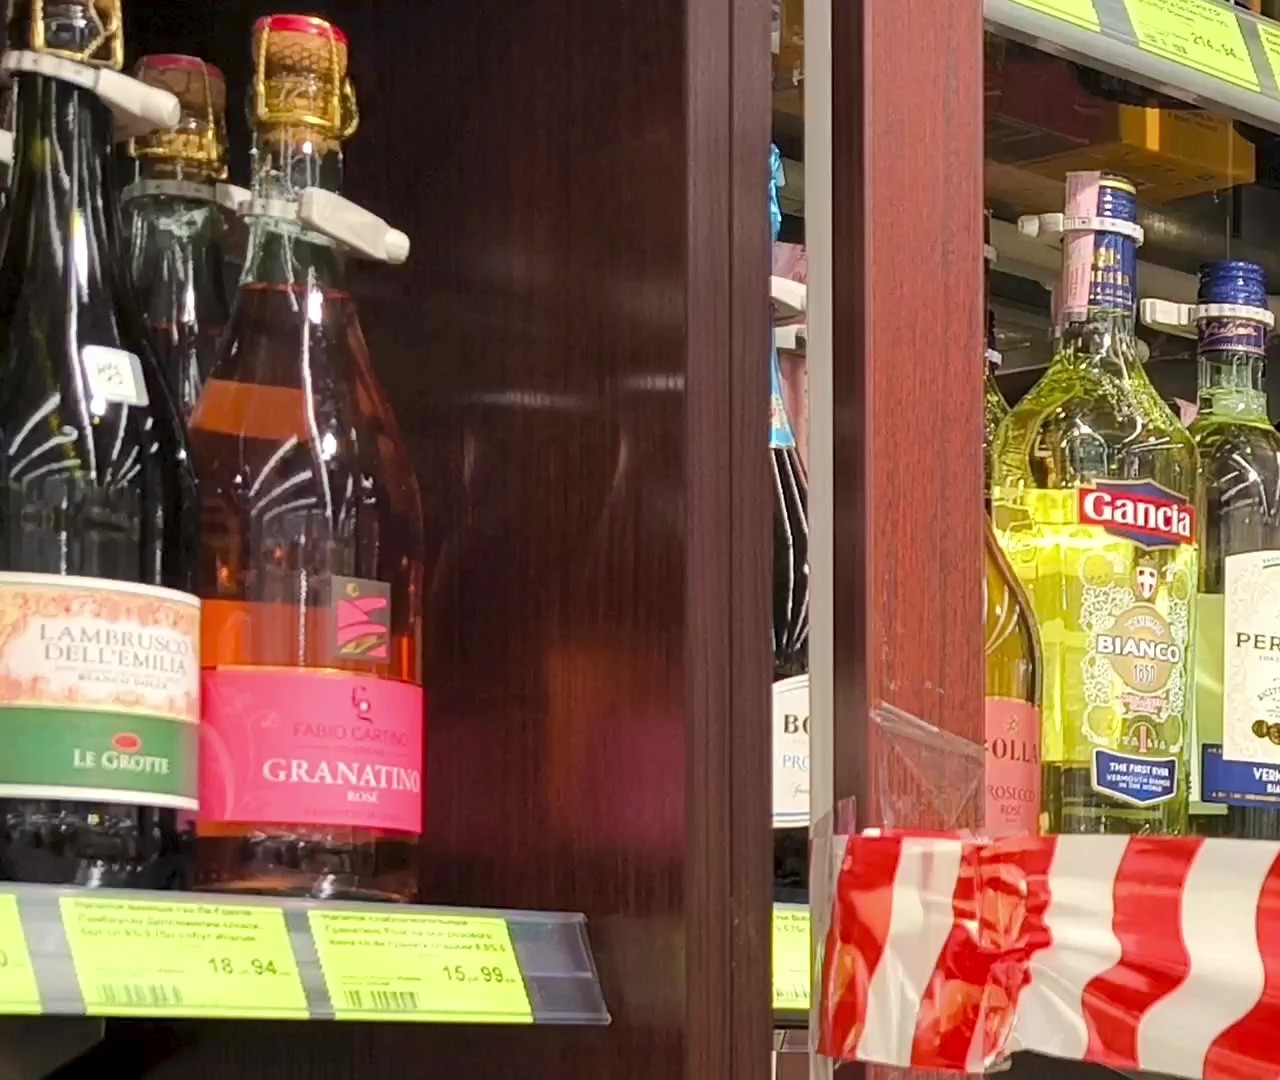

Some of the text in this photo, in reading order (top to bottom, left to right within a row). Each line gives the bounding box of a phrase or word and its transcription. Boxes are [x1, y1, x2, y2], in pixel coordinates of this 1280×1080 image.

[1084, 491, 1191, 537] Gancia
[40, 623, 188, 656] LAMBRUSCO
[1096, 635, 1180, 663] BIANCO
[44, 643, 187, 676] DELL'EMILIA
[1133, 663, 1156, 688] 1850
[293, 722, 347, 740] FABIO
[73, 748, 169, 775] LE GROTTE
[985, 737, 1038, 765] OLLA
[262, 757, 420, 793] GRANATINO
[1109, 761, 1169, 777] THE FIRST EVER
[986, 784, 1035, 803] ROSECCO
[209, 957, 277, 976] 18 94
[442, 965, 504, 983] 15 99
